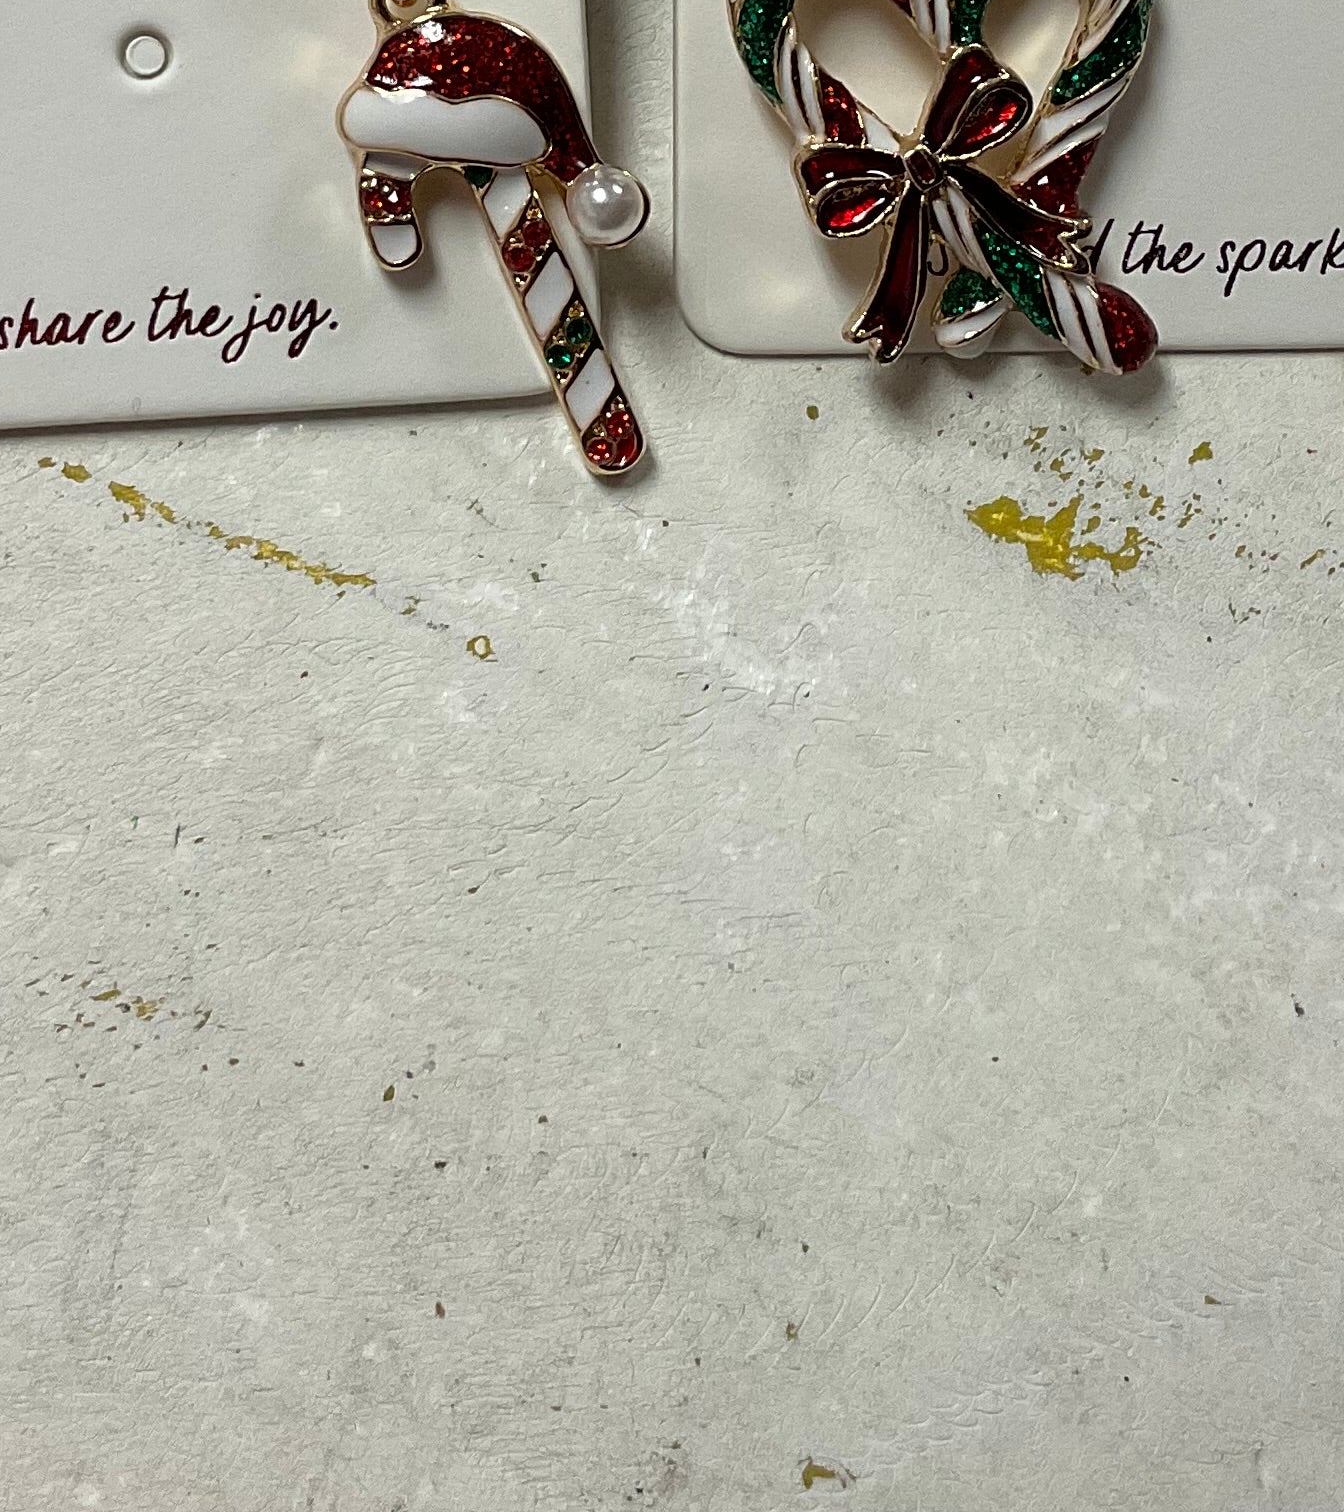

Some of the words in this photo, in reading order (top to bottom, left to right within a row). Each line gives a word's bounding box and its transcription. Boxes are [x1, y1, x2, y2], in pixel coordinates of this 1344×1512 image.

[1121, 219, 1207, 276] the
[146, 284, 235, 343] the
[220, 291, 340, 365] joy.
